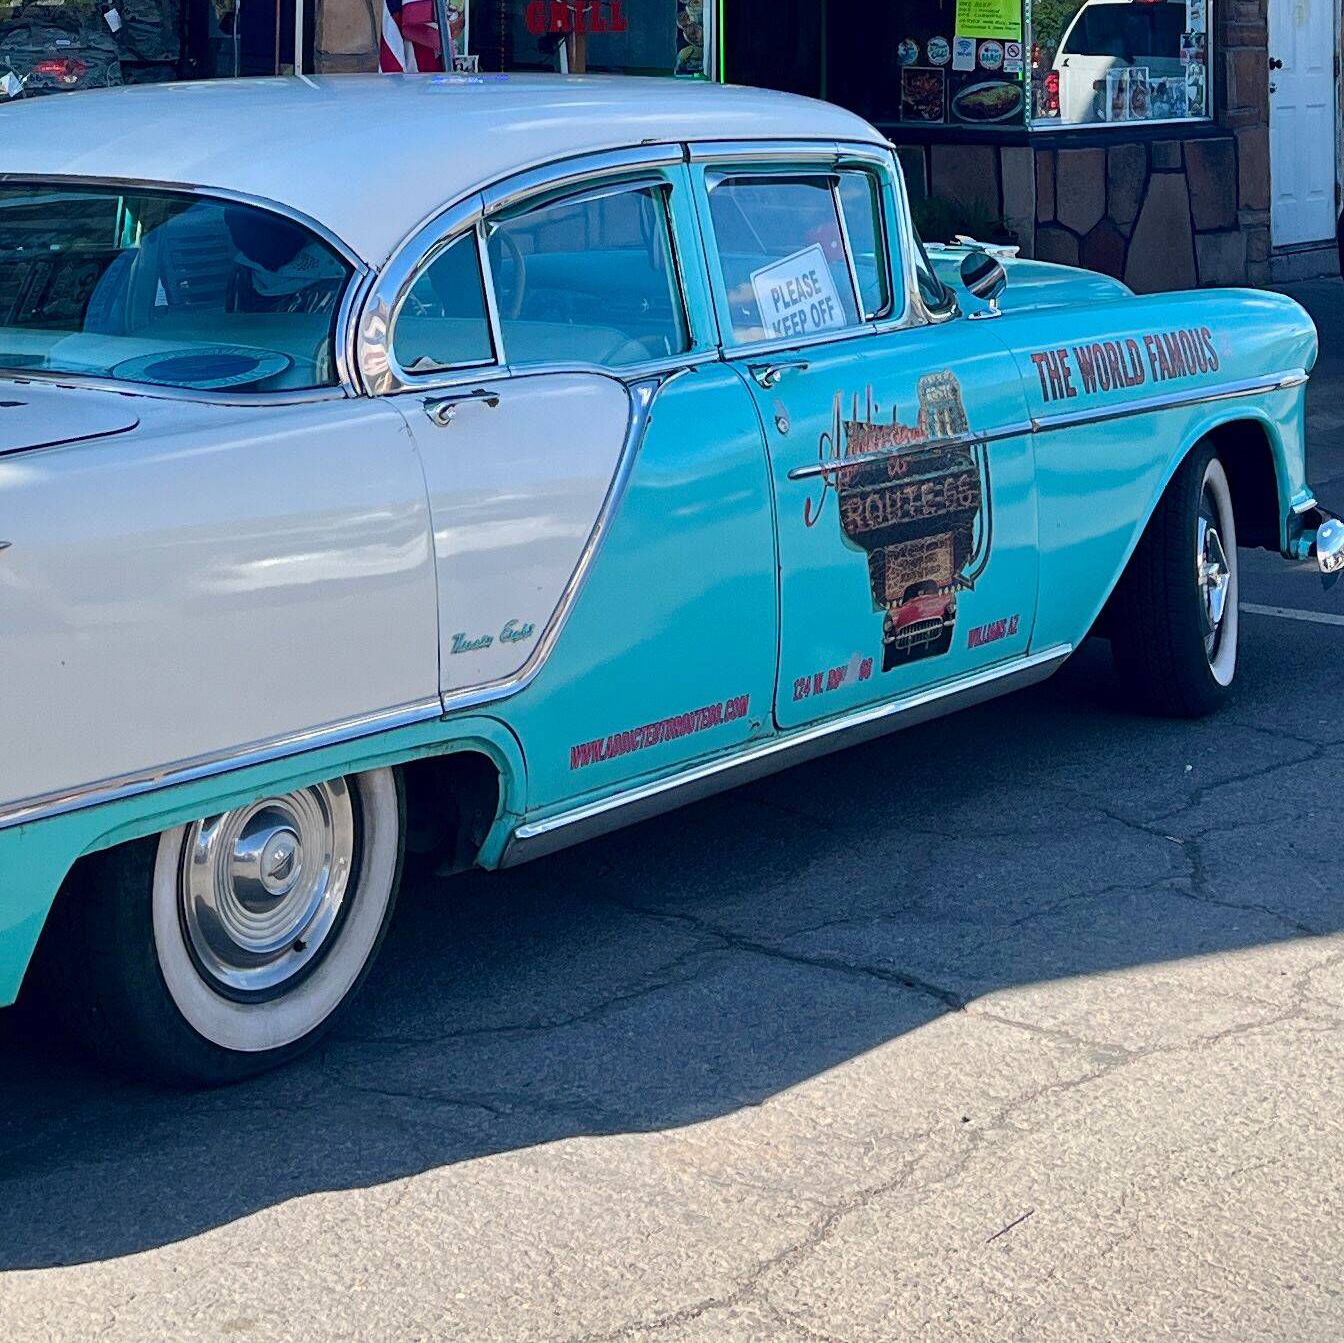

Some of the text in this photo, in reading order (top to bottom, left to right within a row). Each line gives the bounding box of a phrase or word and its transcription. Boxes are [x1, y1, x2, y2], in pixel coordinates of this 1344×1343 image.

[770, 269, 823, 314] PLEASE
[772, 295, 835, 338] KEEP OFF
[1030, 325, 1220, 403] THE WORLD FAMOUS
